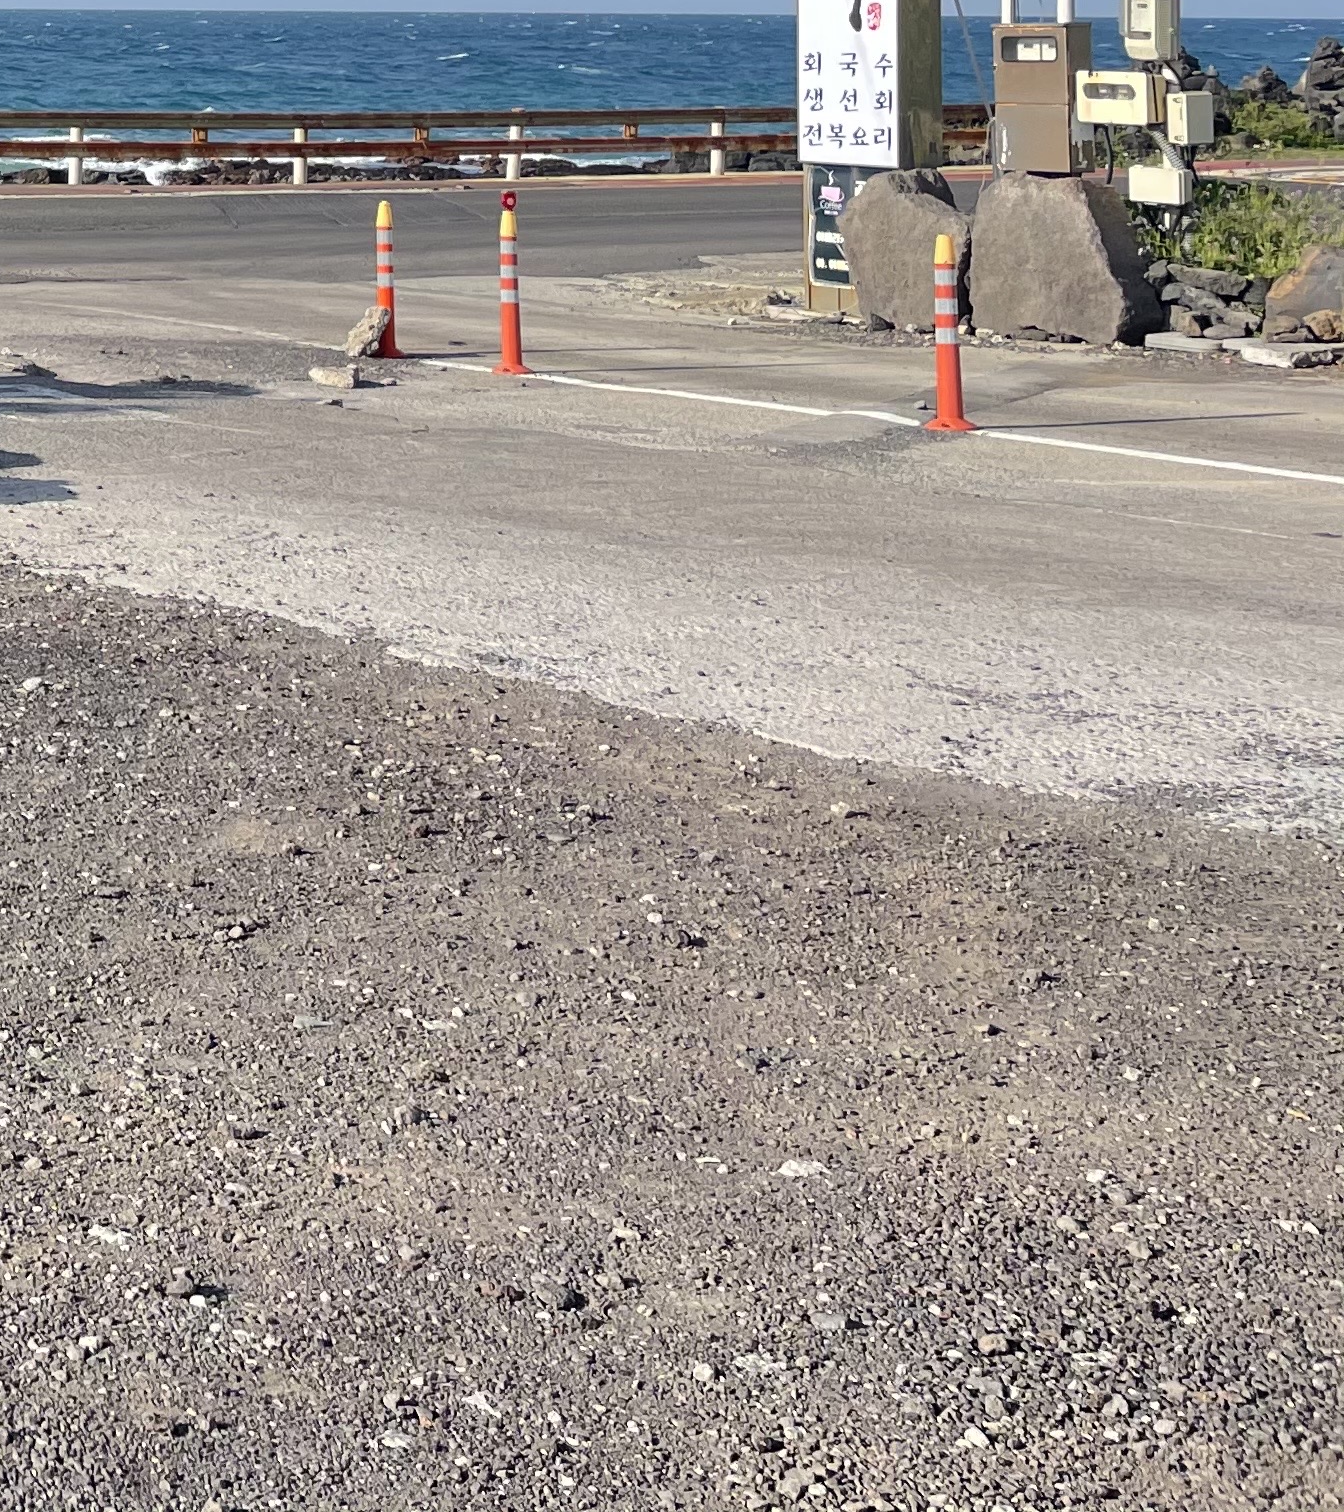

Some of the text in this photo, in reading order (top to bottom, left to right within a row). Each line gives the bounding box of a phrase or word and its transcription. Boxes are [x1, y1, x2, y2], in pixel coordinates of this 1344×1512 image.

[802, 51, 894, 78] 회국수
[803, 87, 893, 115] 생선회
[802, 122, 892, 151] 전복요리
